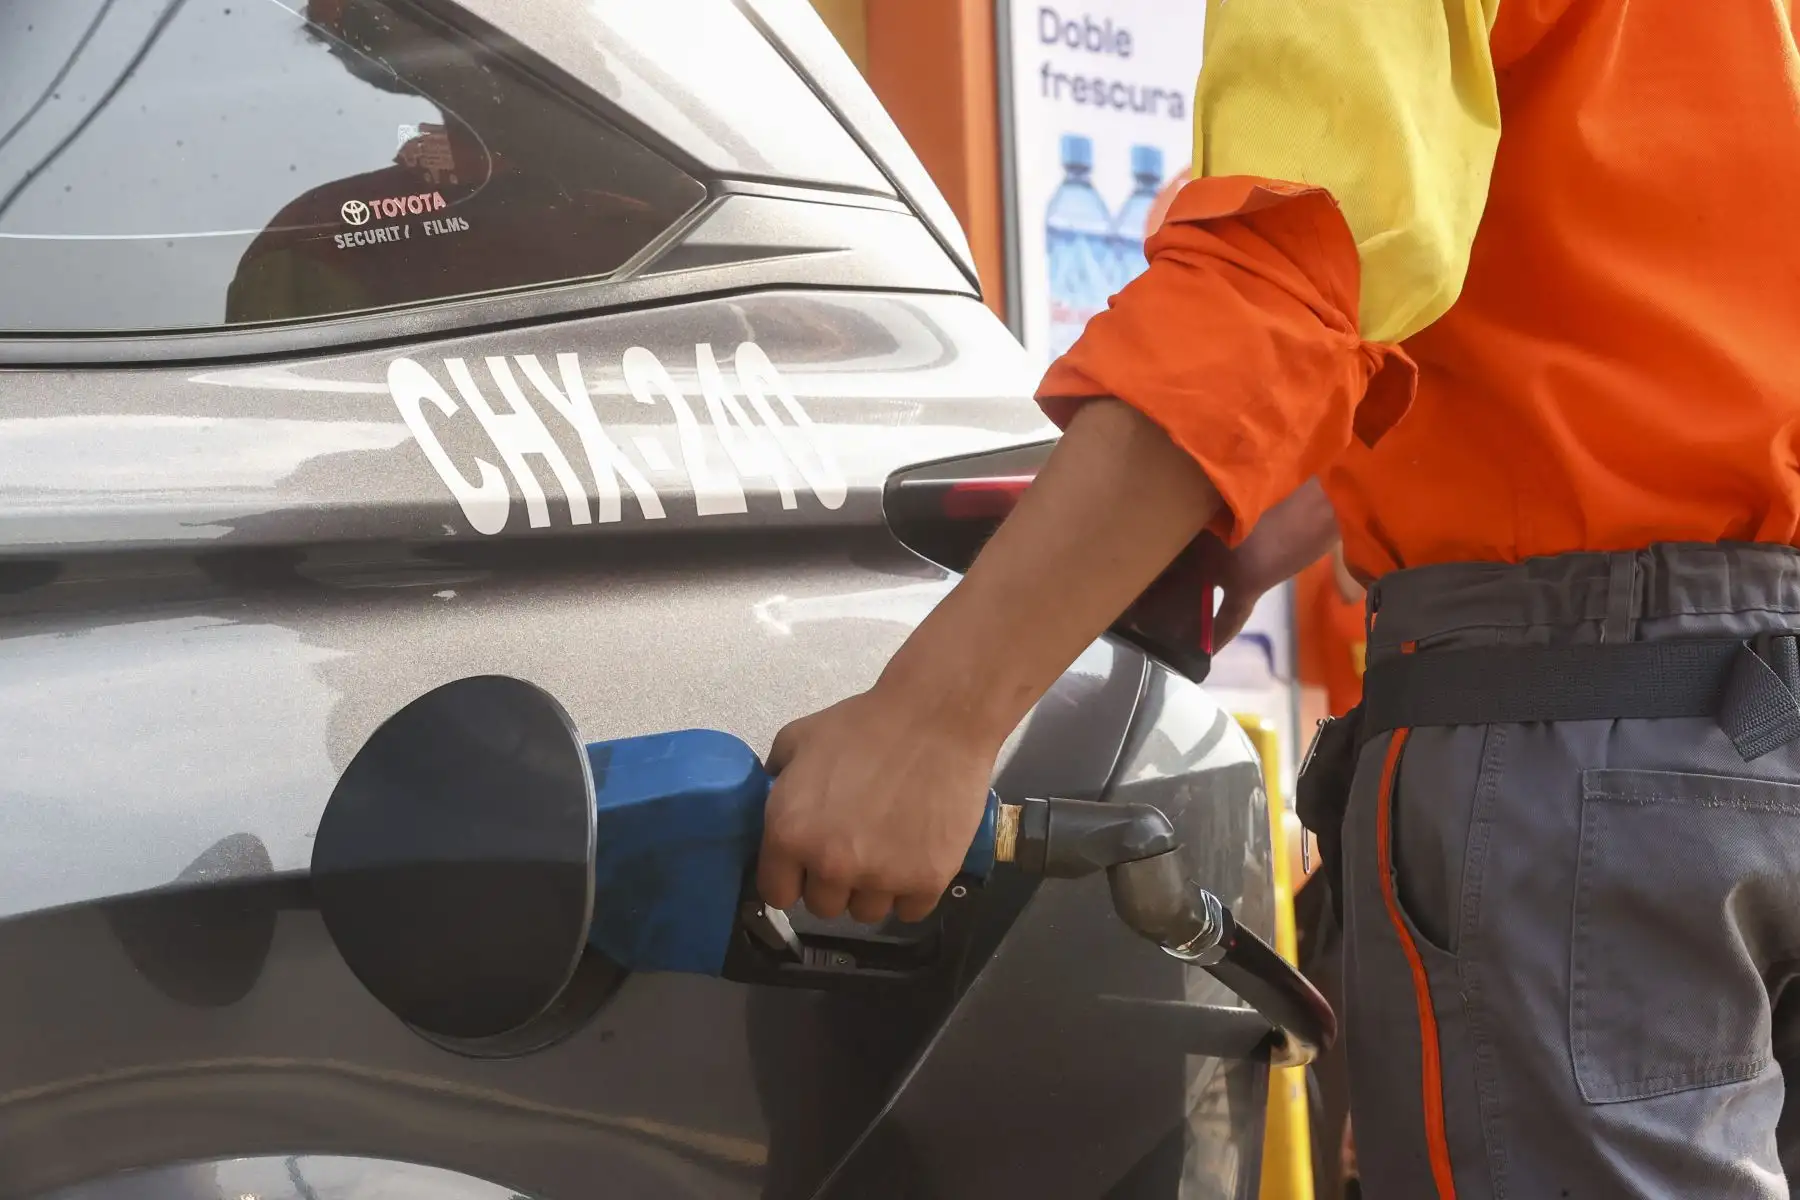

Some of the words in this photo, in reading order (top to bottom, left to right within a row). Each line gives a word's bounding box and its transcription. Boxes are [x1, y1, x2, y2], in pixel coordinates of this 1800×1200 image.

[1040, 8, 1131, 57] Doble
[1040, 62, 1184, 119] frescura
[369, 191, 446, 219] TOYOTA
[422, 217, 470, 236] FILMS
[387, 342, 848, 535] CHX-240
